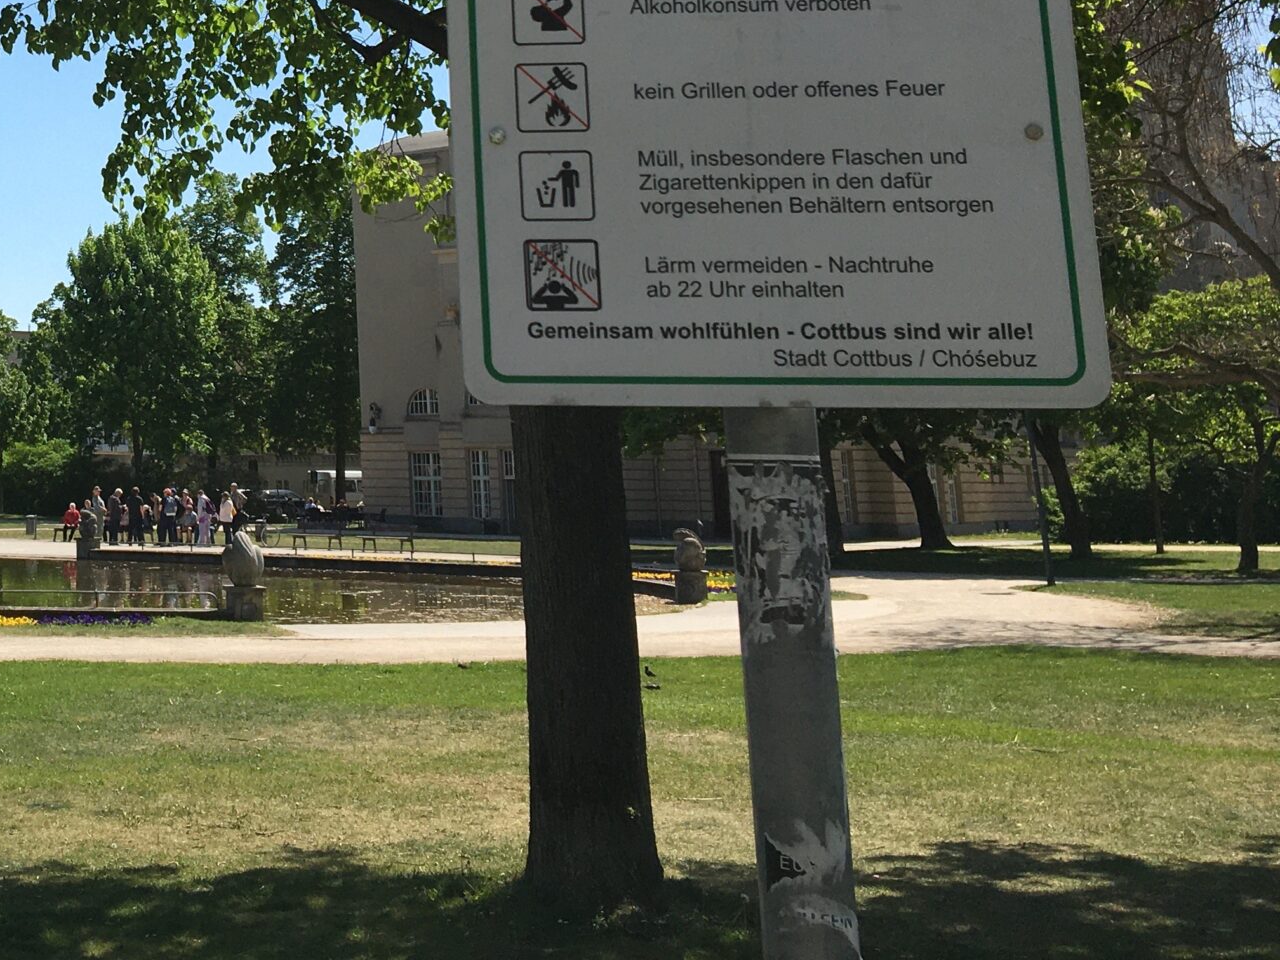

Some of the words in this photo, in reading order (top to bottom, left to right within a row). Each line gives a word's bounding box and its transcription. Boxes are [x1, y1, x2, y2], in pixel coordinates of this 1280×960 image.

[634, 83, 674, 99] kein
[681, 82, 746, 99] Grillen
[753, 81, 799, 98] oder
[804, 81, 879, 97] offenes
[886, 80, 945, 96] Feuer
[638, 150, 684, 169] Müll,
[691, 149, 825, 166] insbesondere
[832, 148, 923, 165] Flaschen
[930, 148, 967, 165] und
[639, 173, 806, 195] Zigarettenkippen
[812, 173, 830, 189] in
[836, 172, 874, 189] den
[880, 172, 932, 189] dafür
[640, 197, 782, 218] vorgesehenen
[789, 196, 886, 213] Behältern
[893, 197, 994, 217] entsorgen
[645, 256, 695, 273] Lärm
[702, 256, 808, 273] vermeiden
[829, 256, 934, 273] Nachtruhe
[647, 281, 671, 298] ab
[678, 281, 703, 298] 22
[709, 280, 746, 298] Uhr
[752, 280, 844, 298] einhalten
[527, 321, 653, 339] Gemeinsam
[659, 322, 779, 340] wohlfühlen
[800, 322, 887, 340] Cottbus
[894, 322, 941, 340] sind
[947, 323, 981, 340] wir
[988, 323, 1033, 340] alle!
[774, 349, 828, 367] Stadt
[833, 349, 912, 367] Cottbus
[919, 349, 925, 367] /
[932, 349, 1037, 367] Chóśebuz
